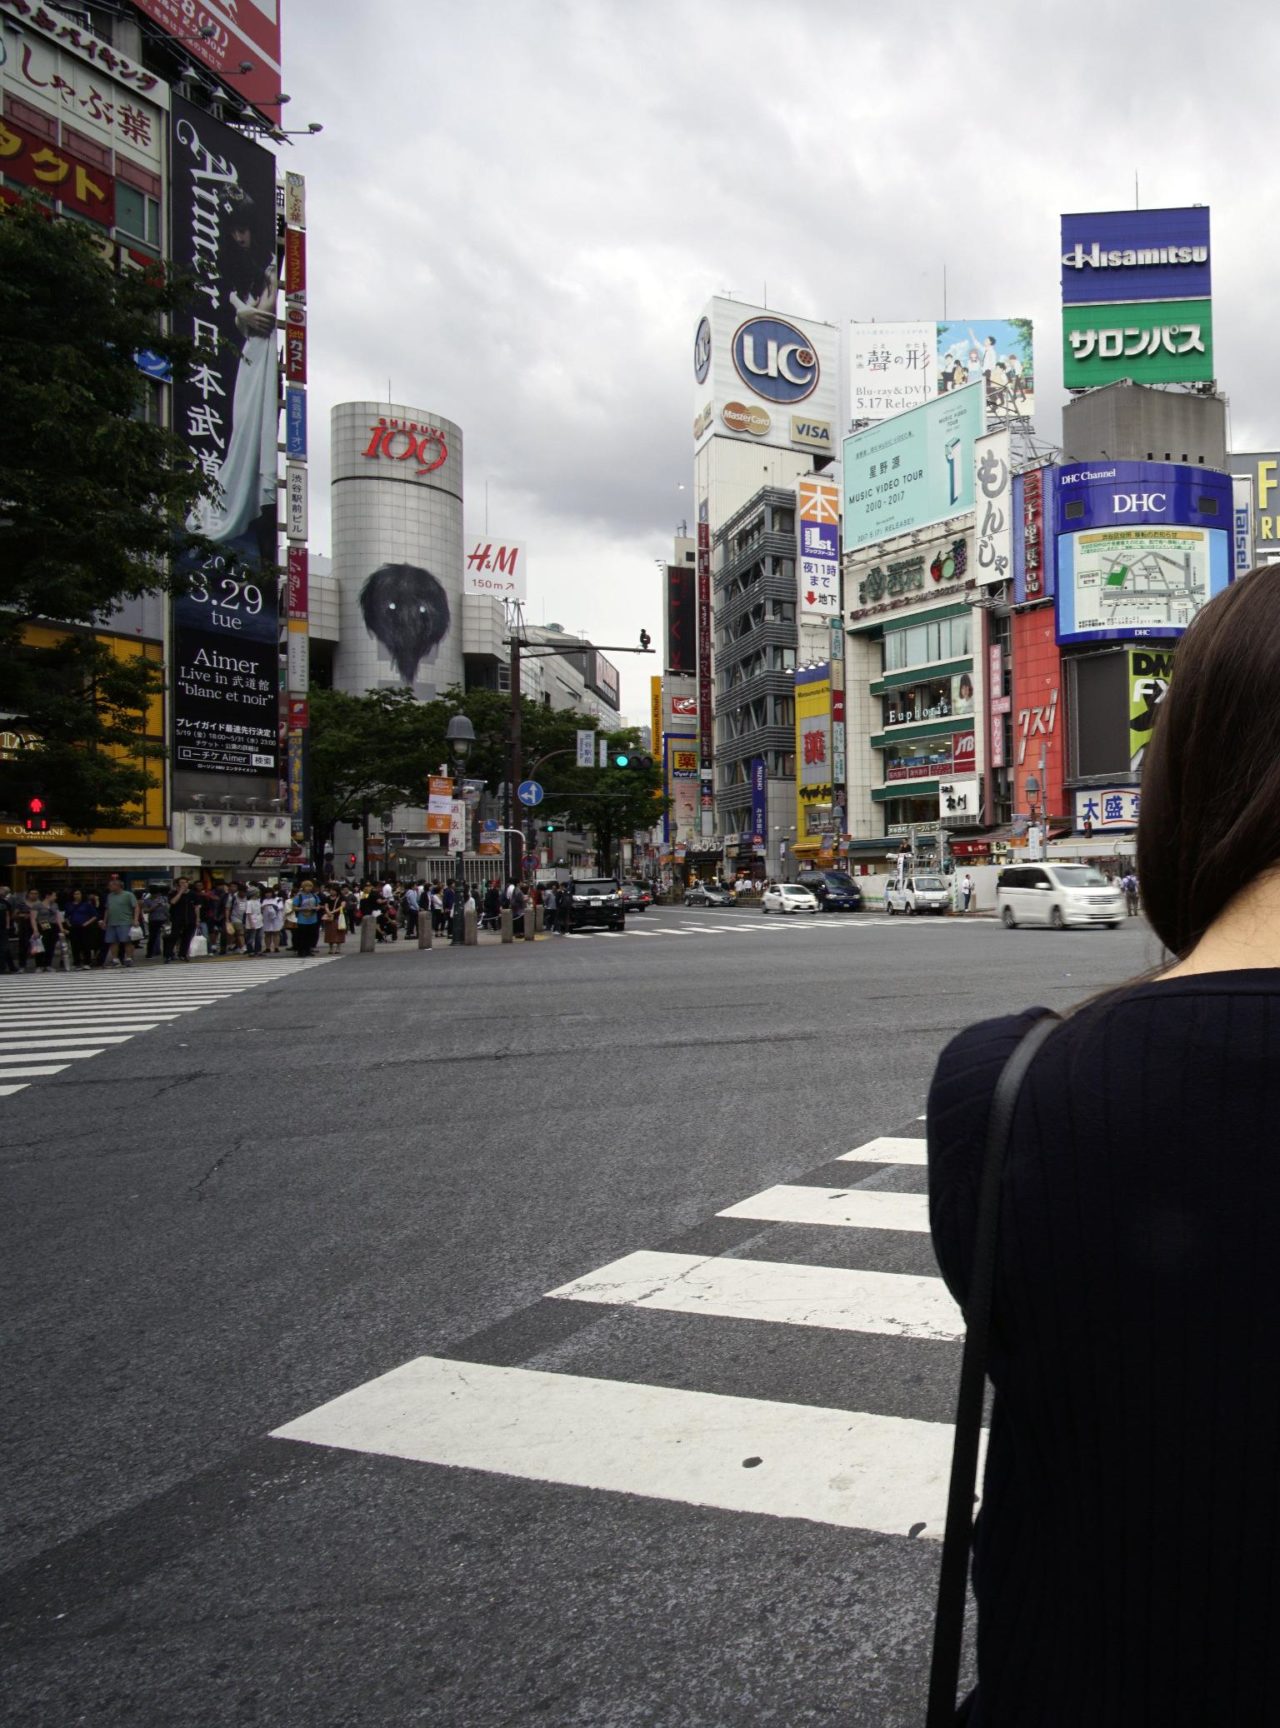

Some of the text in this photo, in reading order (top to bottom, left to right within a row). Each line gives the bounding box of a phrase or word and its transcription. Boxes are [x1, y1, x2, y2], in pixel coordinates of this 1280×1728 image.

[22, 43, 152, 147] しゃぶ葉
[1062, 242, 1208, 269] Hisamitsu
[1069, 324, 1206, 359] サロンパス
[856, 397, 882, 410] 5.17
[379, 417, 446, 441] SHIBUYA
[724, 409, 770, 426] MasterCard
[796, 423, 830, 441] VISA
[362, 426, 448, 476] 109
[869, 455, 901, 479] 星野源
[1061, 469, 1116, 485] DHC Channel
[849, 469, 924, 505] MUSIC VIDEO TOUR
[292, 473, 304, 534] 渋谷駅前ビル
[800, 484, 839, 523] 本
[977, 448, 1010, 577] もんじゃ
[1112, 493, 1167, 514] DHC
[1236, 502, 1250, 571] Taisei
[466, 542, 519, 577] H&M
[803, 562, 837, 577] 夜11時
[809, 575, 831, 588] まで
[818, 592, 837, 606] 地下
[212, 611, 242, 631] tue
[194, 649, 260, 676] Aimer
[180, 666, 270, 692] Live in 武道館
[226, 691, 239, 702] et
[889, 704, 948, 723] Euphoria
[1018, 687, 1058, 765] クスリ
[955, 736, 975, 756] JTB
[183, 750, 273, 767] ローチケ Aimer 検索
[678, 753, 697, 769] 薬
